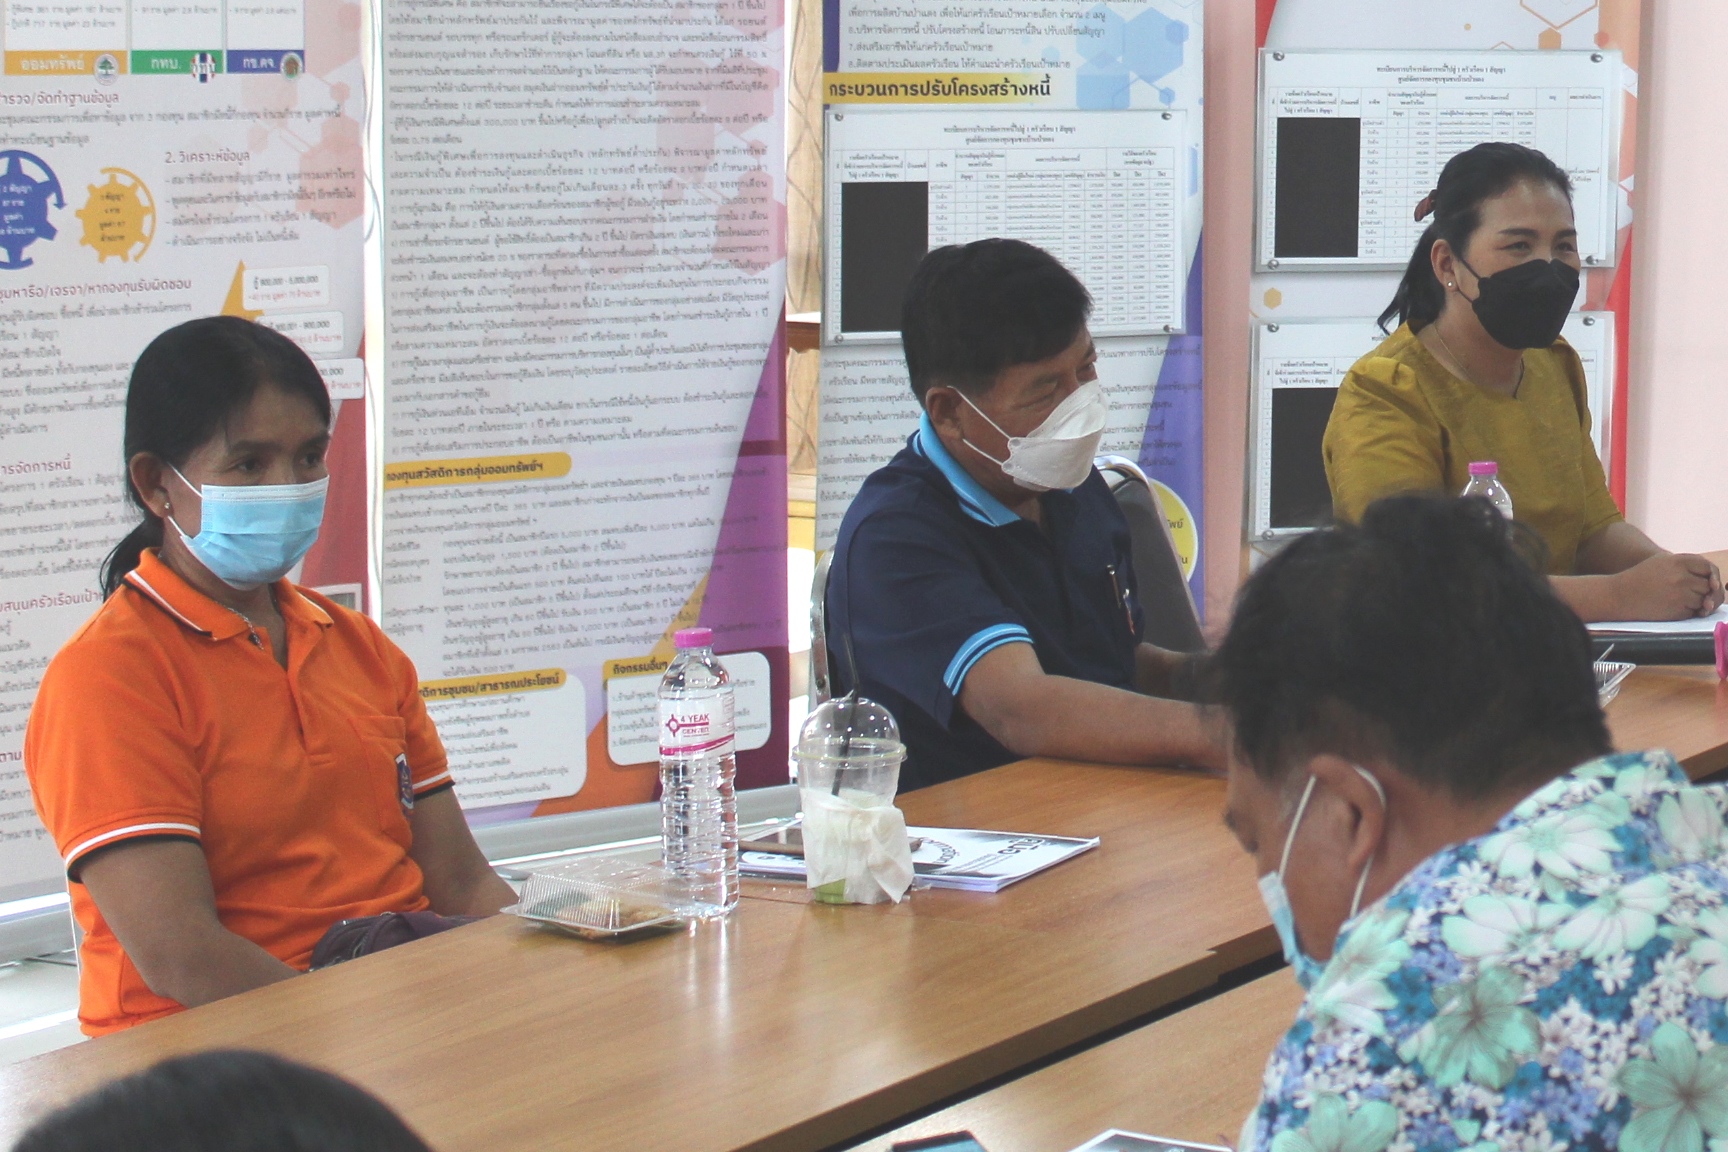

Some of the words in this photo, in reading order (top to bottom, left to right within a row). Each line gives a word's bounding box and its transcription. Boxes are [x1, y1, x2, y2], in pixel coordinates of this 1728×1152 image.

[21, 54, 85, 71] ออมทรัพย์
[829, 73, 1051, 98] กระบวนการปรับโครงสร้างหนี้
[165, 152, 176, 164] 2.
[179, 149, 250, 167] วิเคราะห์ข้อมูล
[0, 453, 71, 475] ารจัดการหนี้
[687, 713, 710, 723] YEAK
